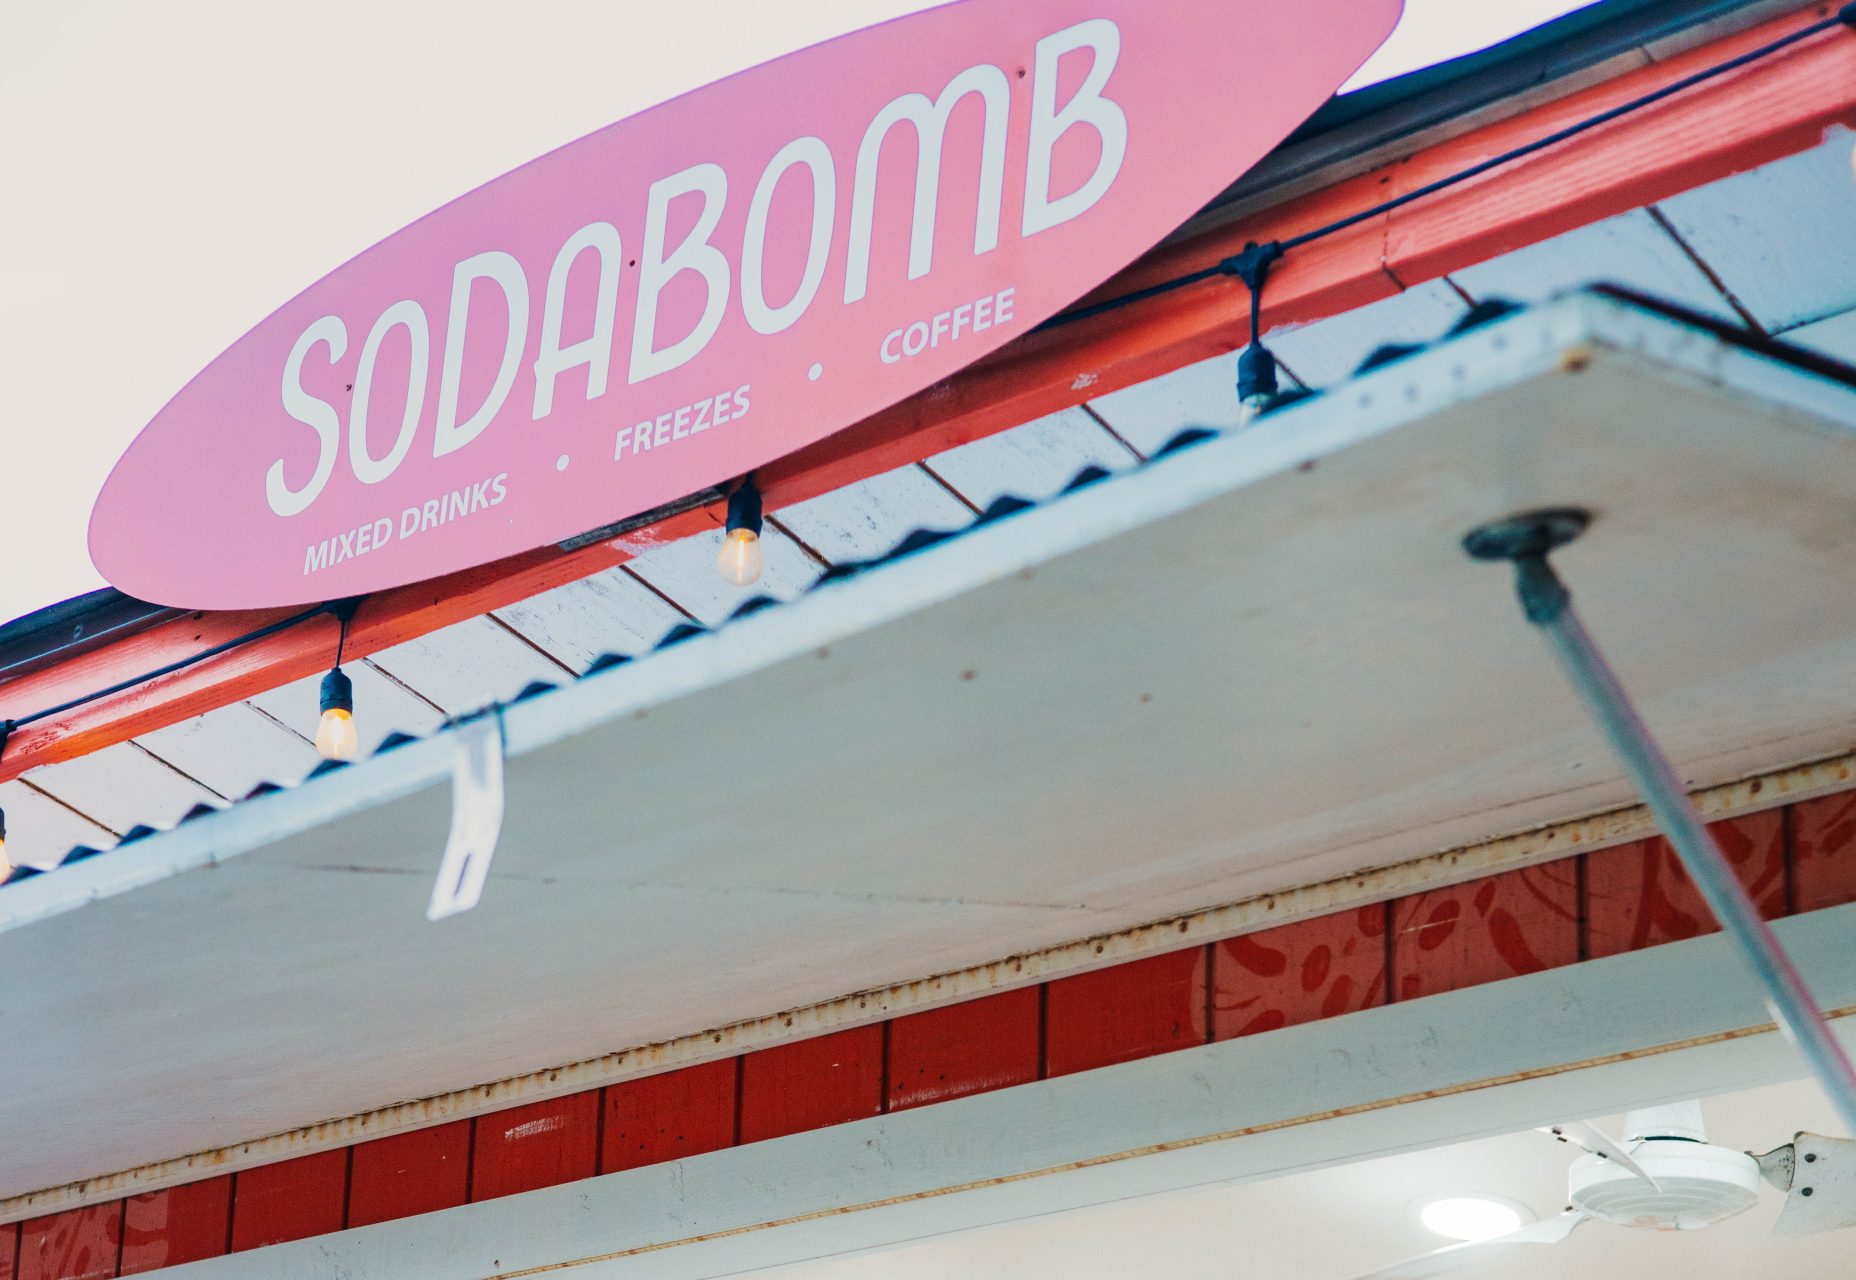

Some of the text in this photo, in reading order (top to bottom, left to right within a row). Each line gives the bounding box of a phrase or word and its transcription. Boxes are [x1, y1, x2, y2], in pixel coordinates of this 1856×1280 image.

[265, 18, 1129, 518] SODABOMB
[879, 287, 1016, 365] COFFEE
[613, 384, 752, 462] FREEZES
[303, 473, 508, 577] MIXED DRINKS
